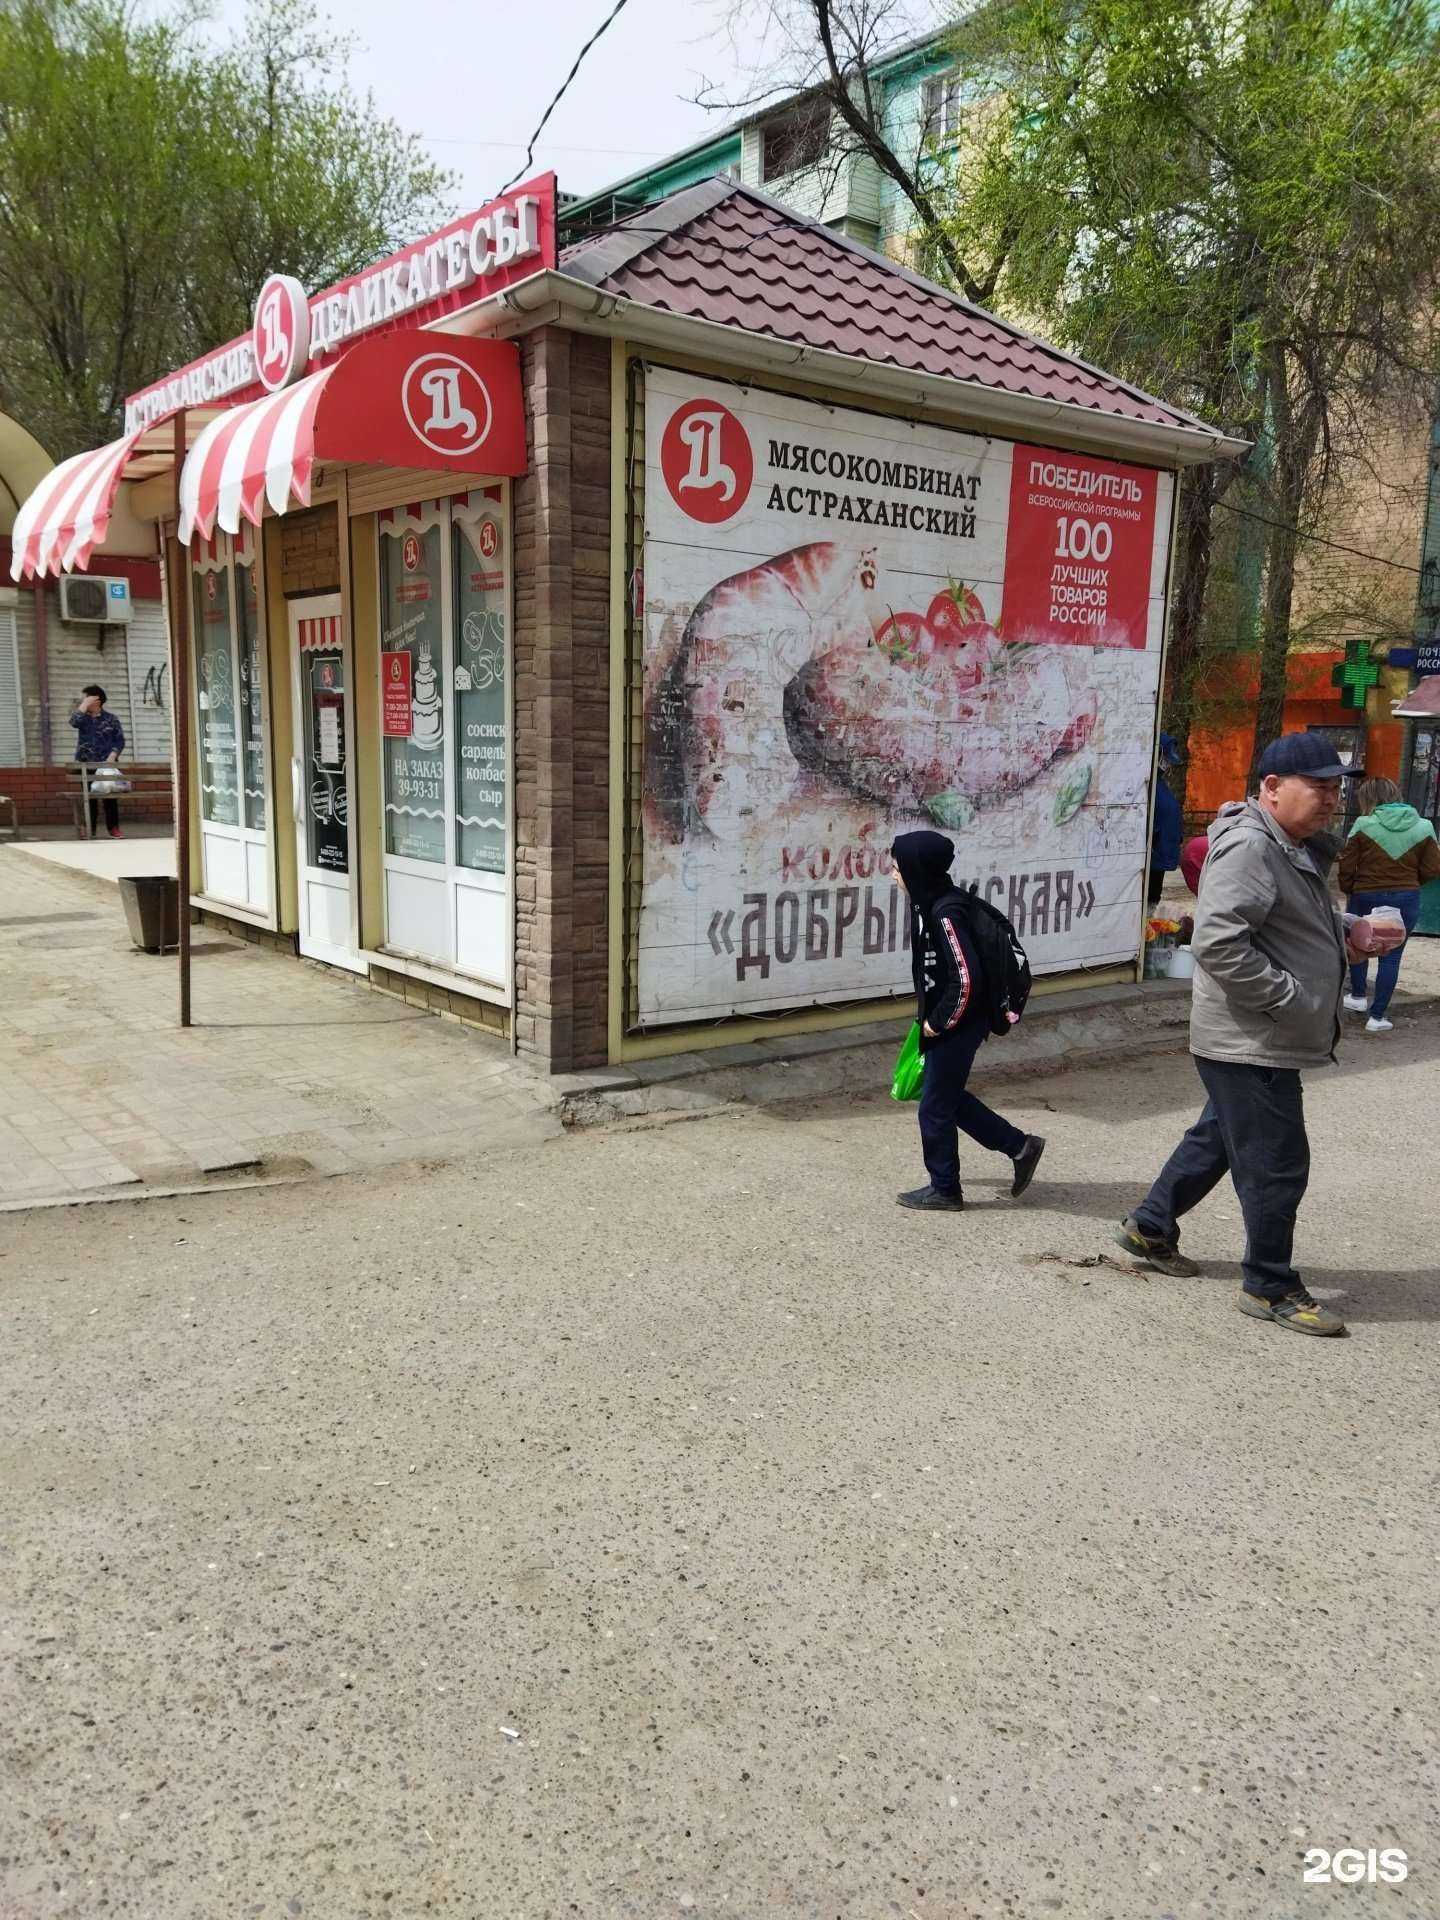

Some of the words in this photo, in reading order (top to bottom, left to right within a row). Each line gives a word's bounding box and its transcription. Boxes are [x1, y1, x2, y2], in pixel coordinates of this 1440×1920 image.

[308, 194, 541, 361] ДЕЛИКАТЕСЫ
[767, 439, 982, 501] МЯСОКОМБИНАТ
[1029, 461, 1143, 502] ПОБЕДИТЕЛЬ
[766, 483, 977, 539] АСТРАХАНСКИЙ
[1028, 493, 1095, 515] ВСЕРОССИЙСКОЙ
[1094, 503, 1141, 521] ПРОГРАММЫ
[1055, 516, 1113, 562] 100
[1050, 564, 1109, 587] ЛУЧШИХ
[1050, 584, 1108, 607] ТОВАРОВ
[1049, 605, 1107, 626] РОССИИ
[1418, 647, 1440, 657] ПОЧ
[394, 759, 409, 776] НА
[410, 759, 443, 779] ЗАКАЗ
[398, 779, 440, 800] 39-93-31
[479, 789, 503, 807] сыр
